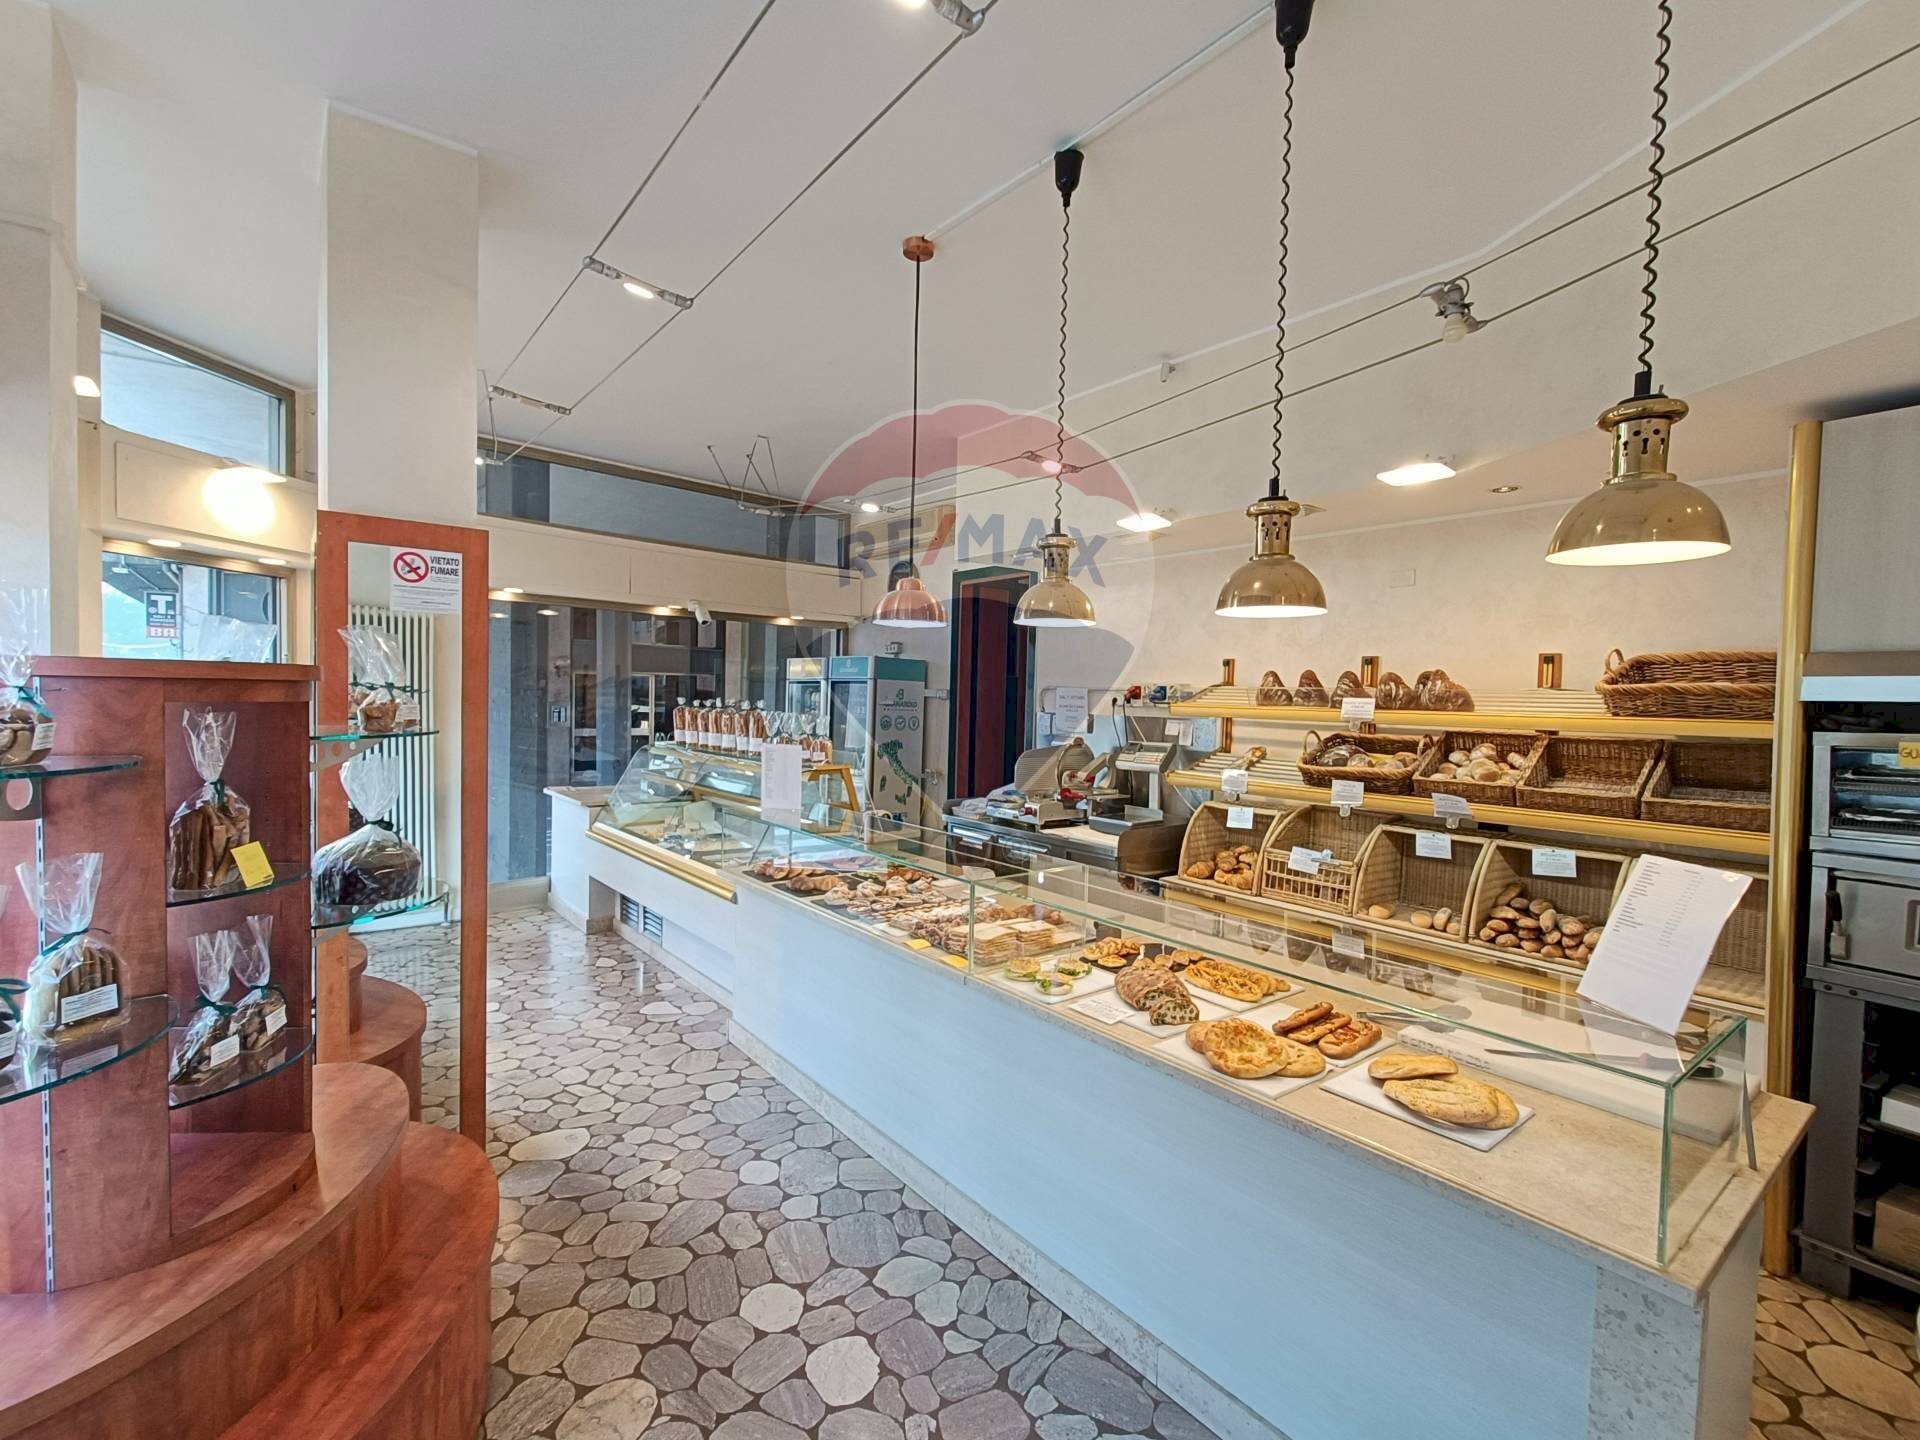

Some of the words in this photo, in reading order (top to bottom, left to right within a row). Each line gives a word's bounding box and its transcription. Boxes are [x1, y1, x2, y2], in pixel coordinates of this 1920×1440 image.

[429, 556, 460, 567] VIETATO
[430, 566, 460, 577] FUMARE
[150, 594, 173, 615] T
[1901, 747, 1920, 759] GU
